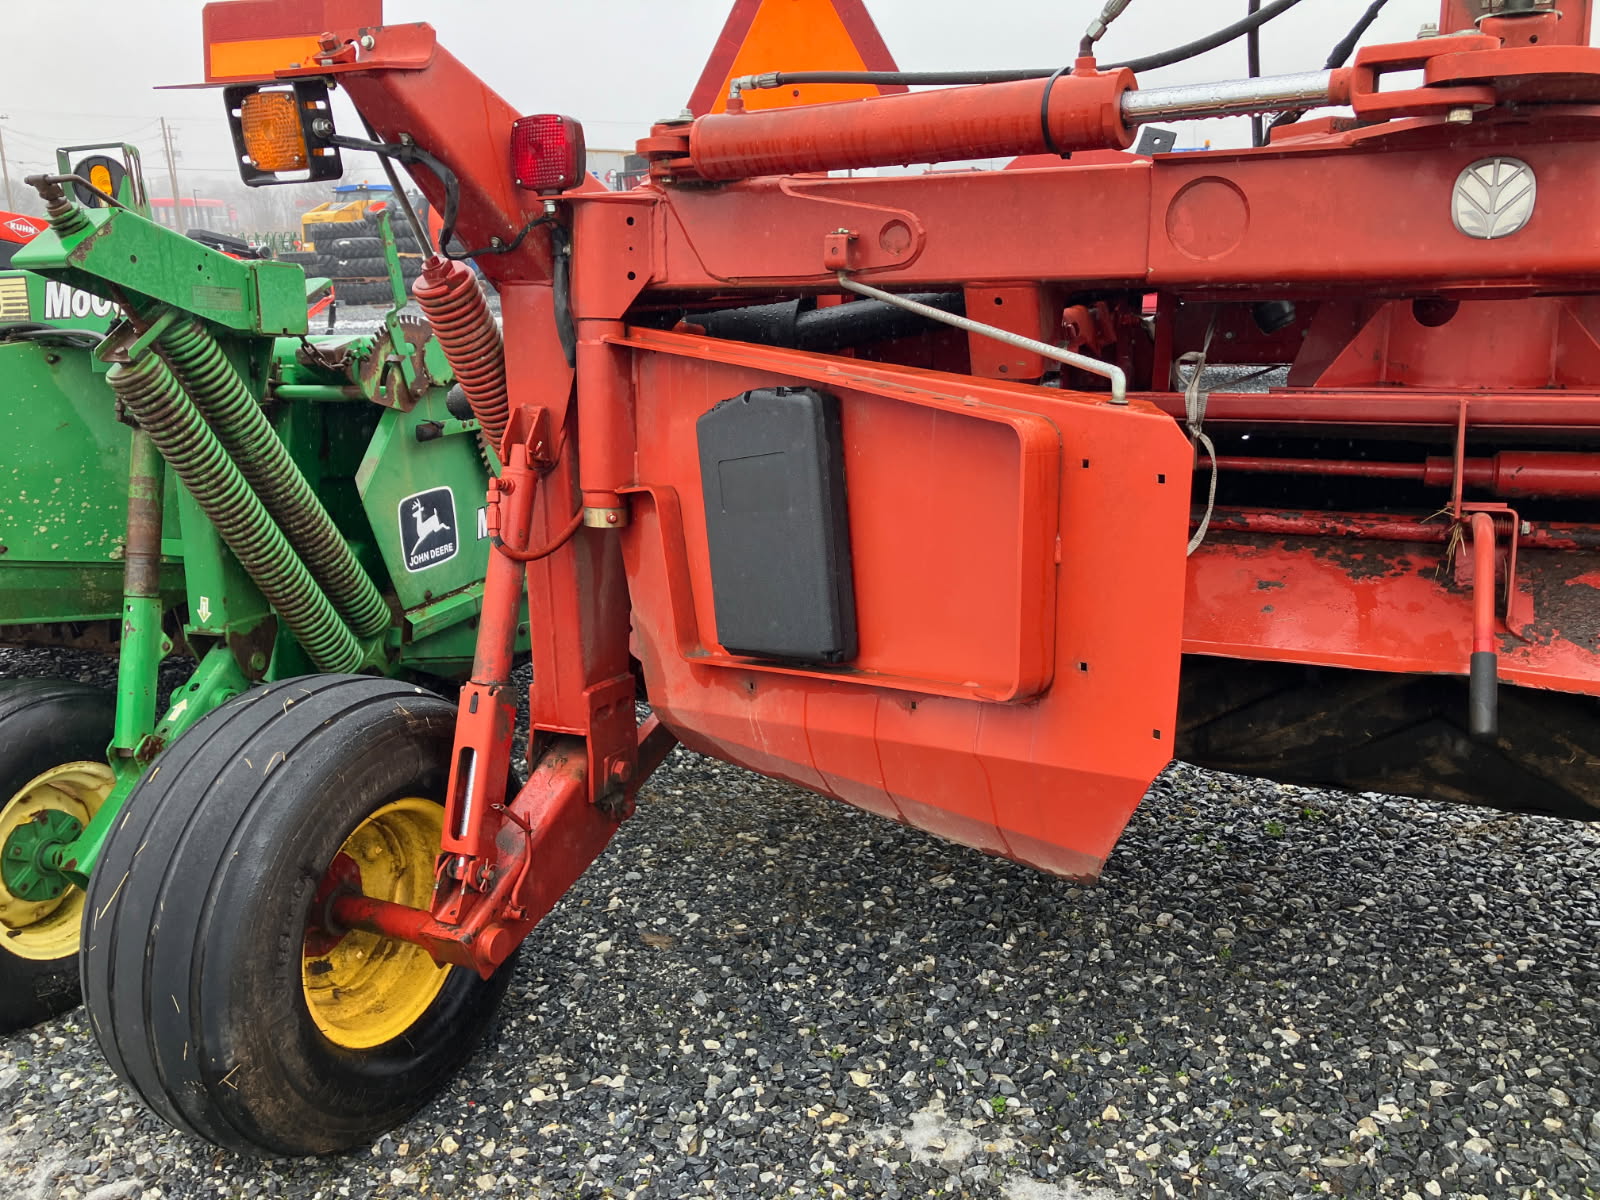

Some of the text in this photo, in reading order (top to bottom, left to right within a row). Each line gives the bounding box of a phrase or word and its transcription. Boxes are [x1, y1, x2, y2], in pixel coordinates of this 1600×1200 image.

[10, 222, 36, 235] KUHN
[409, 542, 454, 566] JOHN DEERE
